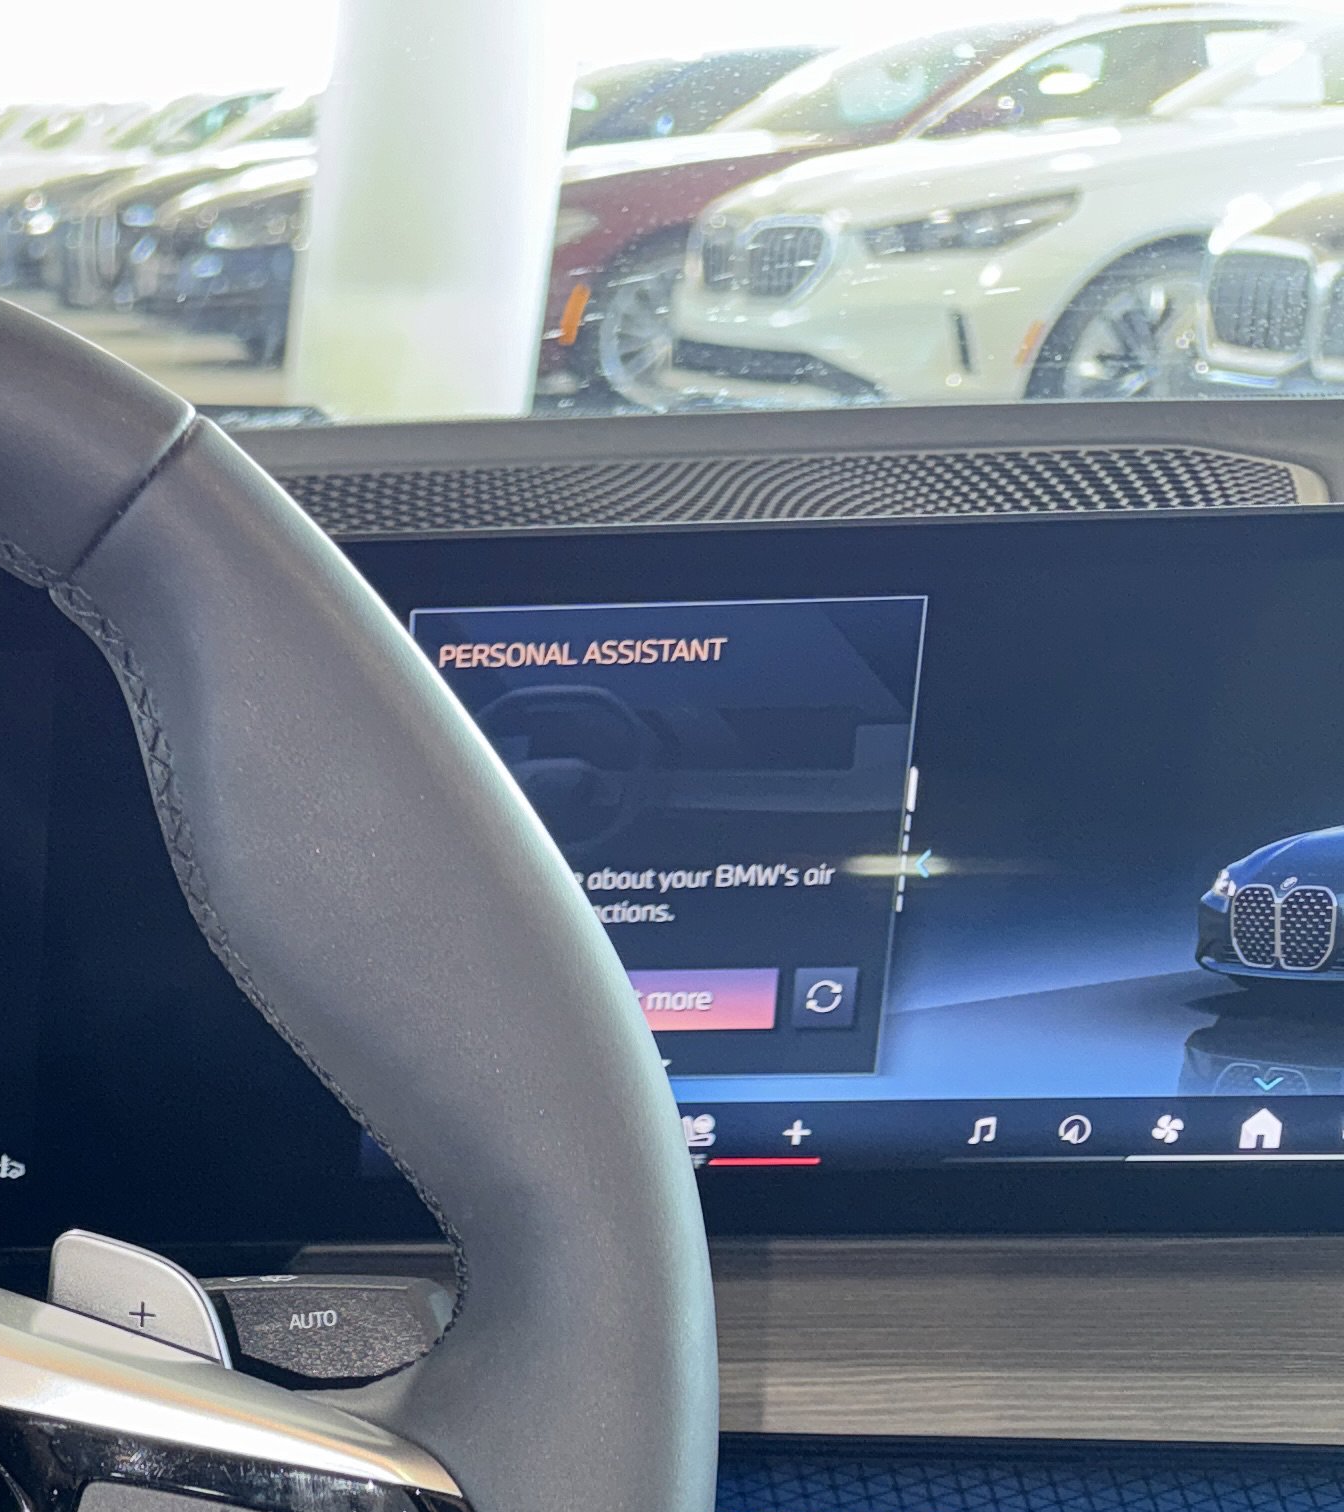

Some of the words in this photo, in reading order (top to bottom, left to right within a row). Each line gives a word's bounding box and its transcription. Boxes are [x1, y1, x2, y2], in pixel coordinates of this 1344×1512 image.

[438, 641, 578, 668] PERSONAL
[582, 637, 728, 665] ASSISTANT
[587, 867, 657, 890] about
[658, 869, 712, 893] your
[714, 863, 800, 888] BMW's
[803, 863, 837, 886] air
[646, 990, 713, 1011] more
[288, 1309, 338, 1331] AUTO
